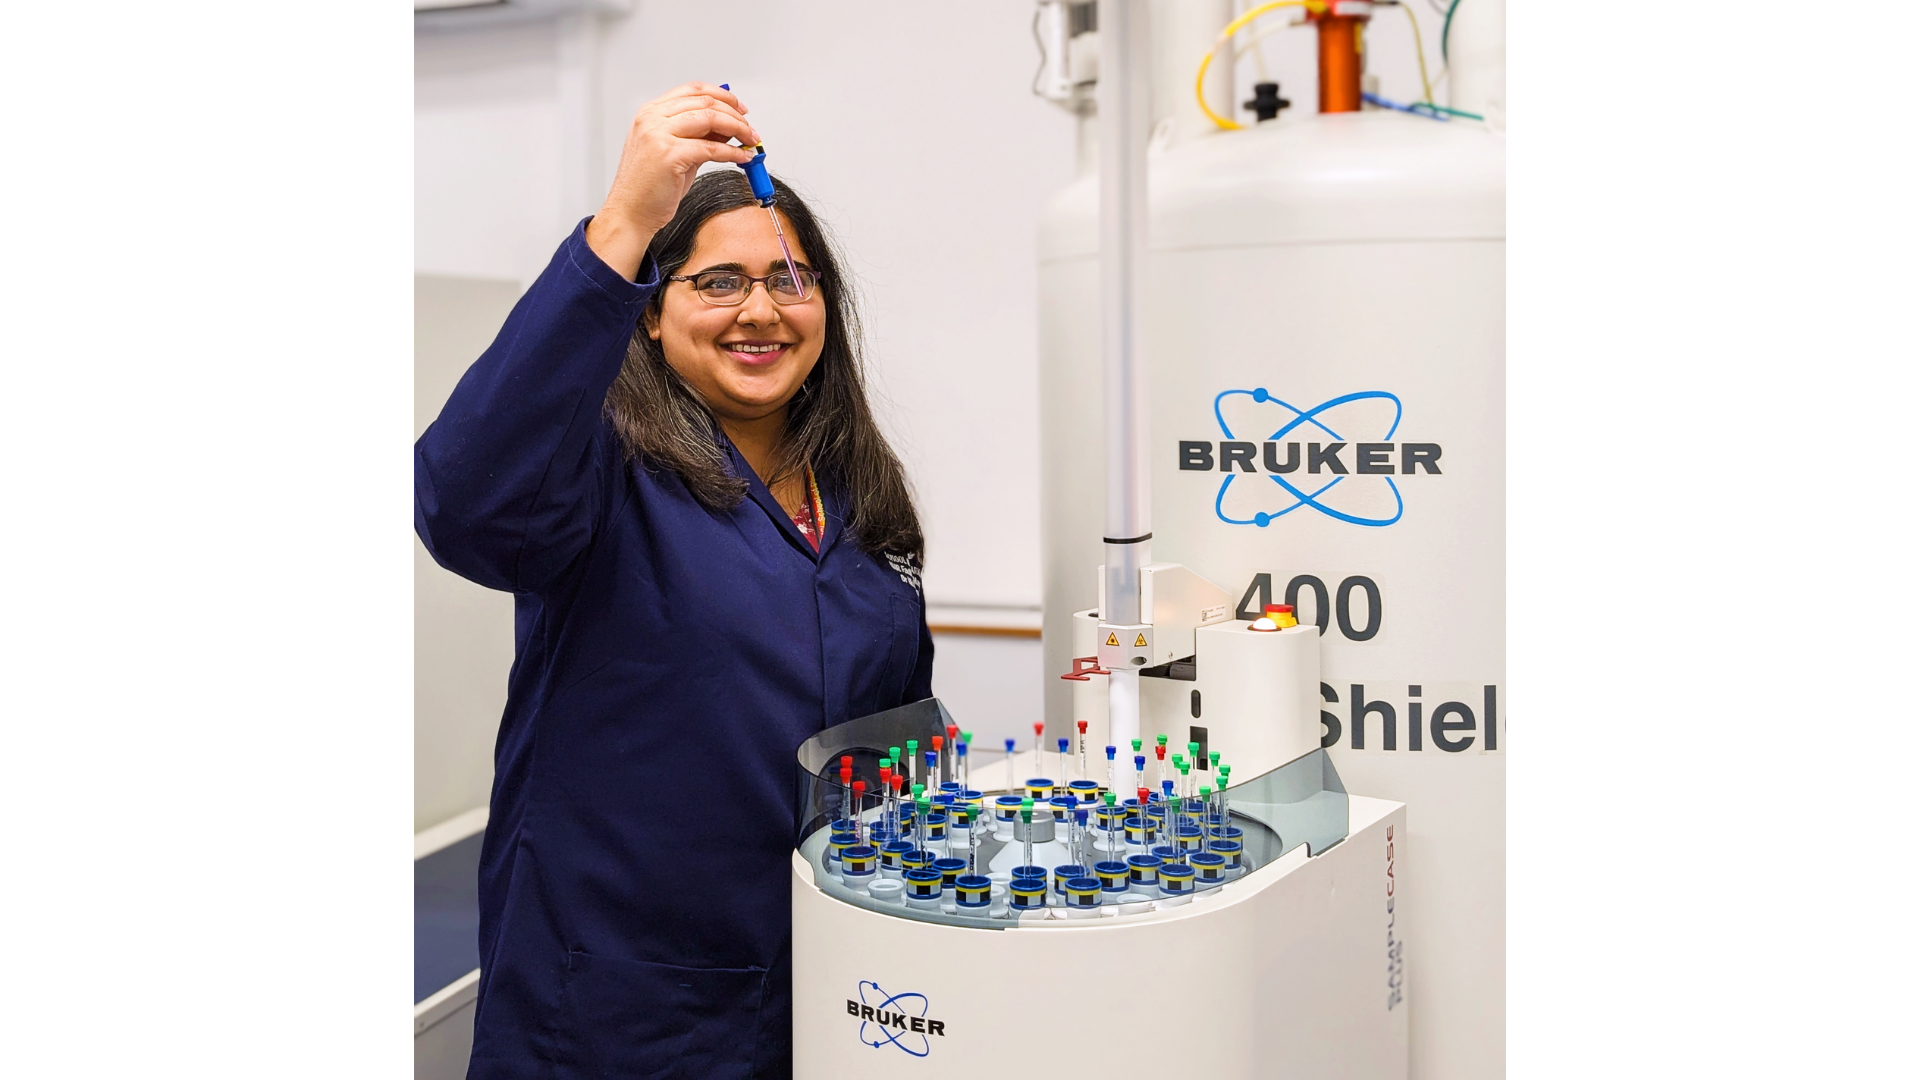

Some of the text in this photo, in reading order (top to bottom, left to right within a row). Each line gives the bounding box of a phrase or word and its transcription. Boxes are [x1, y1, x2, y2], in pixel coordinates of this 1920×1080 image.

[1179, 440, 1443, 475] BRUKER
[1236, 573, 1382, 642] 400
[1320, 681, 1506, 753] hiel
[846, 998, 946, 1037] BRUKER
